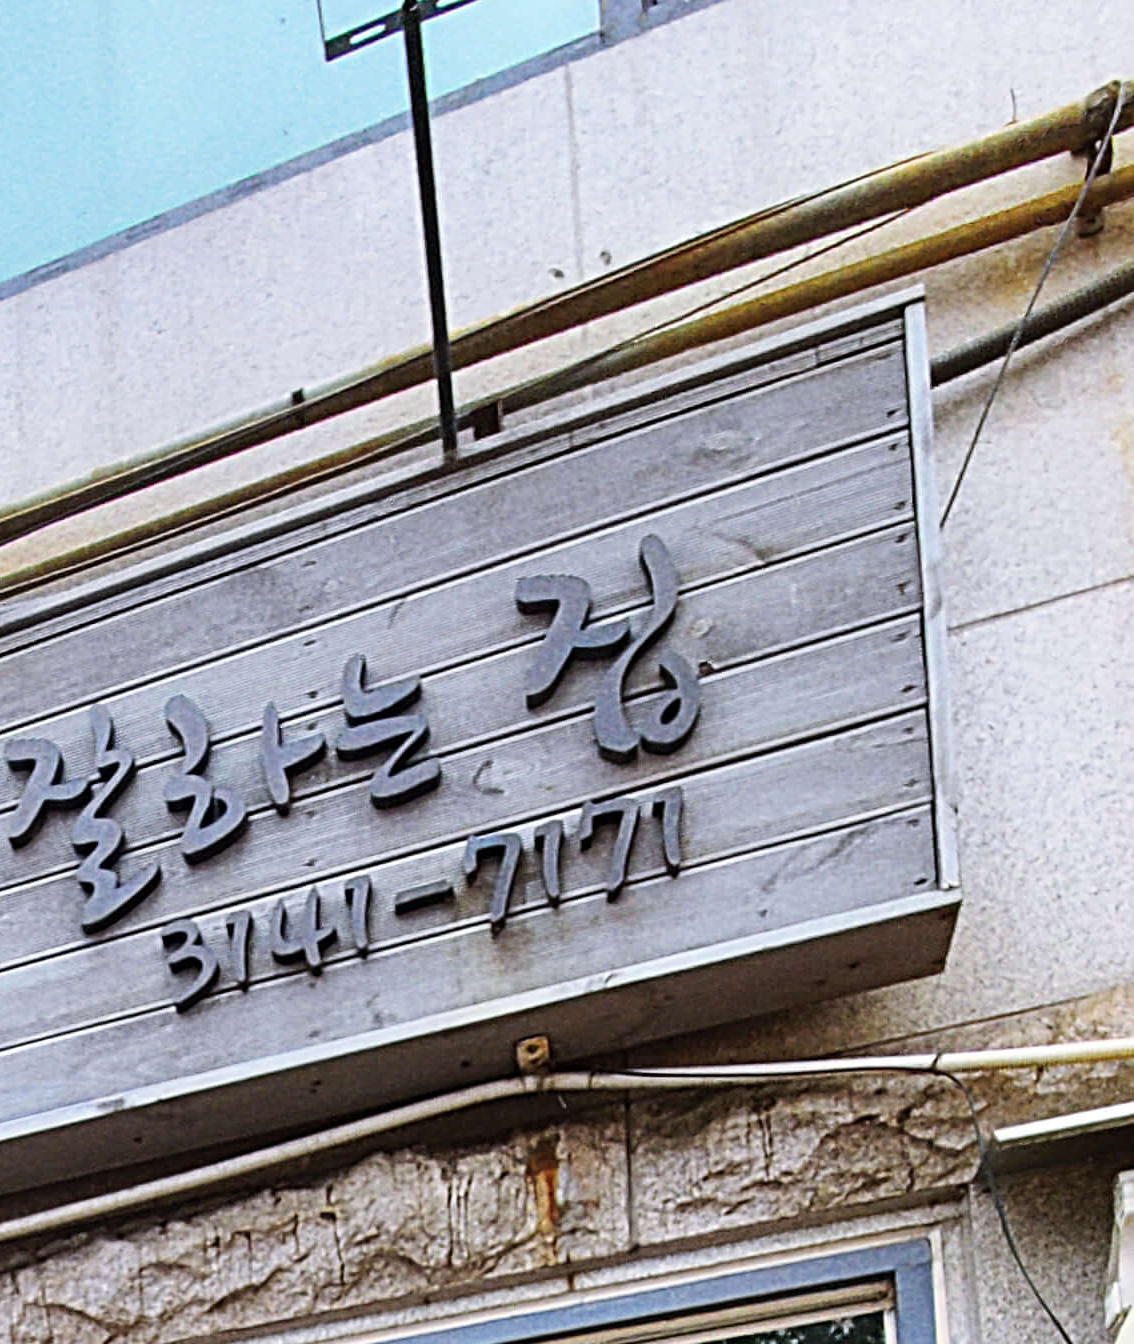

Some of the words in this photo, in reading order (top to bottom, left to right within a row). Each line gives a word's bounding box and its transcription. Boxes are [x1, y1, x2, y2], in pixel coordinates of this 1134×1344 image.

[5, 653, 442, 935] 잘하는
[515, 534, 702, 763] 집
[162, 786, 685, 1014] 3141-7171
